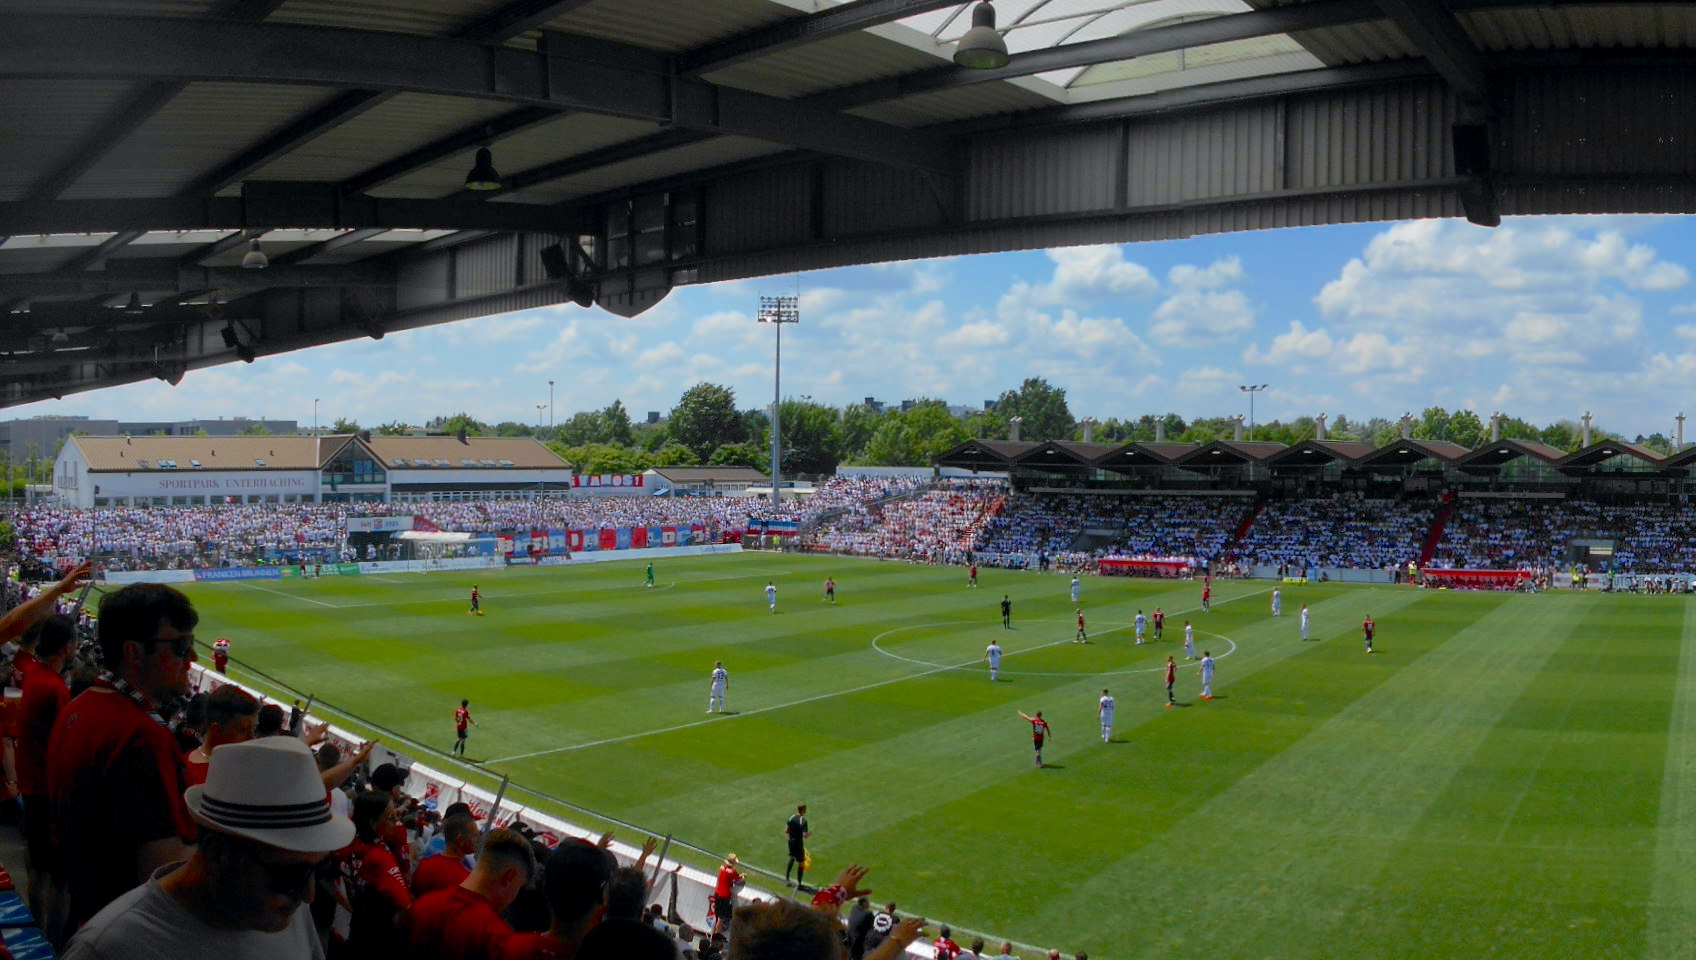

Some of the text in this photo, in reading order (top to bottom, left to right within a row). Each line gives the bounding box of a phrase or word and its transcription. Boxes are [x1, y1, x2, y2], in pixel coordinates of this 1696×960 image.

[159, 478, 305, 489] SPORTPARK UNTERHACHING
[203, 568, 279, 579] FRANKEN BRUNNEN
